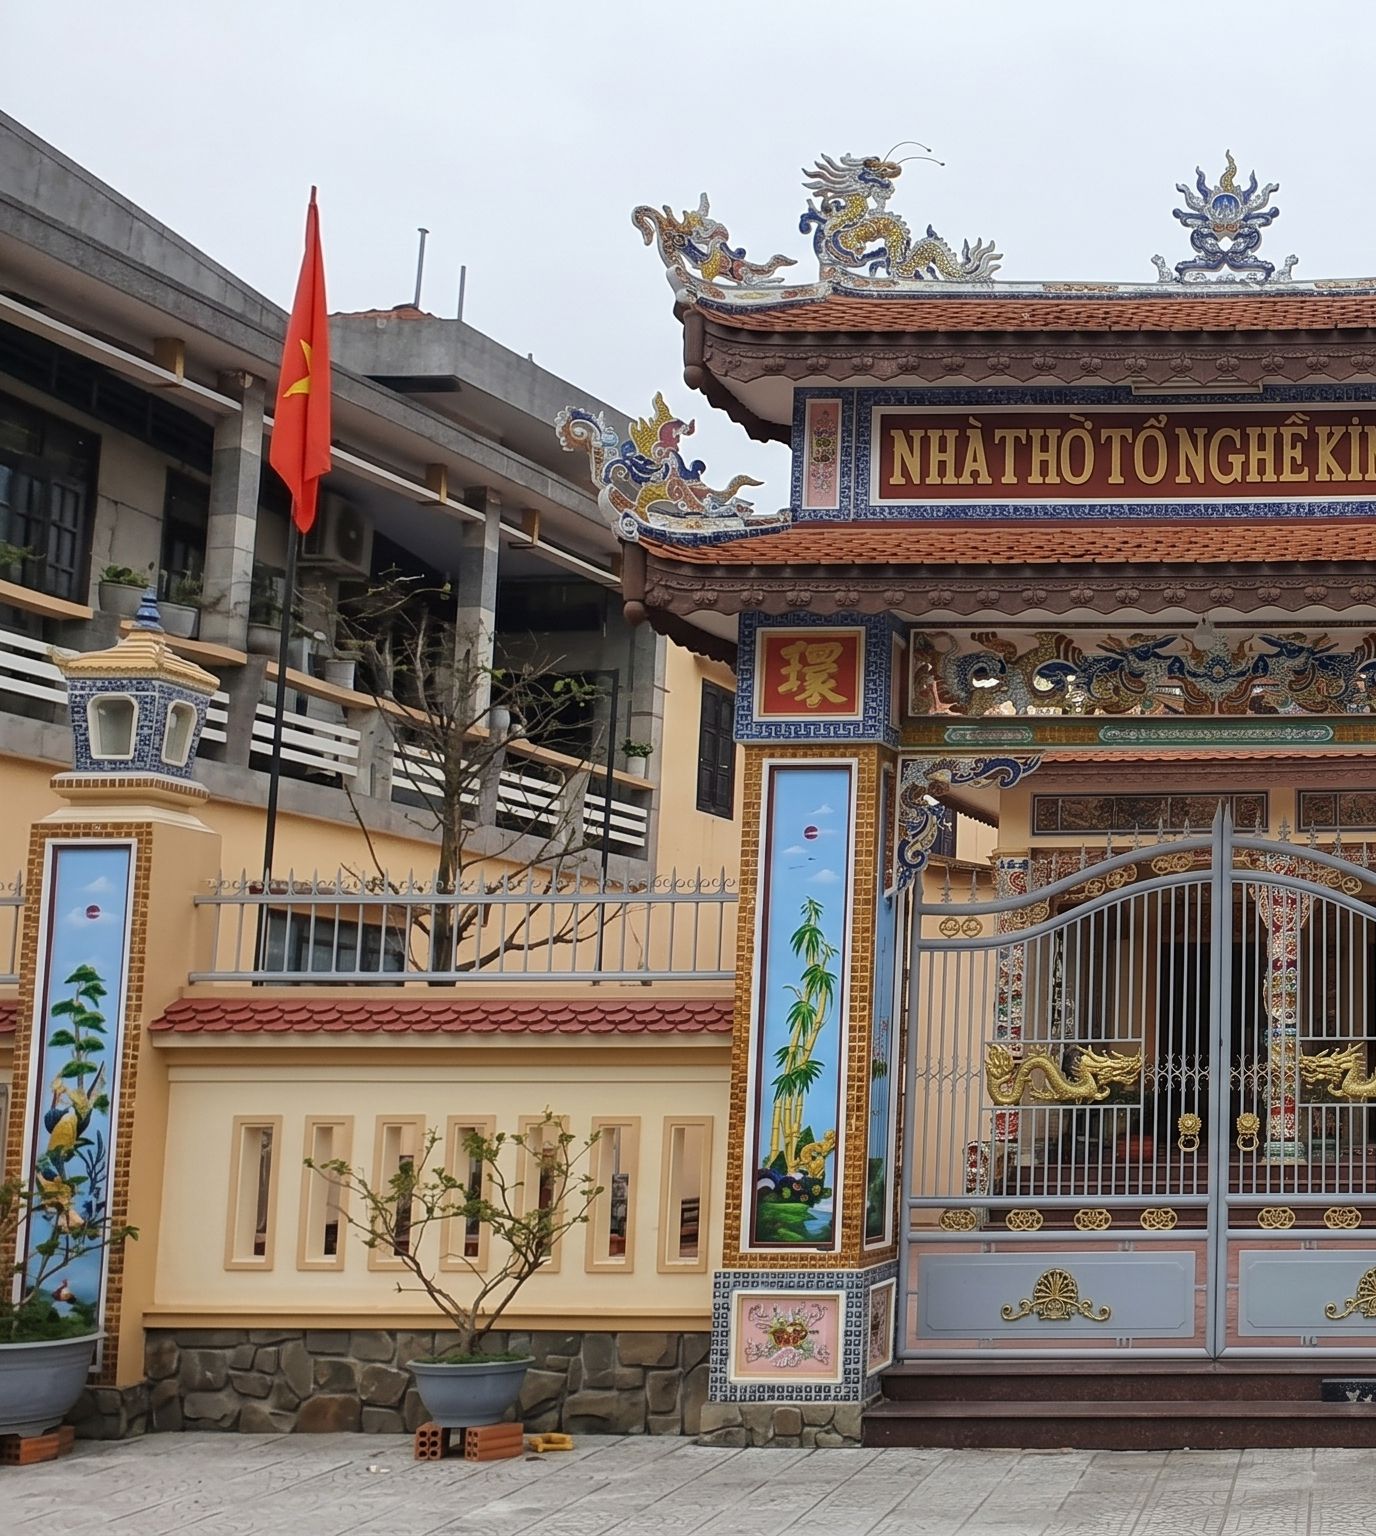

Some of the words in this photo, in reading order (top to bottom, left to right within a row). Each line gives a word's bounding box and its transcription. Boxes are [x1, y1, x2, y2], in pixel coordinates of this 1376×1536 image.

[889, 416, 992, 485] NHÀ
[994, 413, 1094, 485] THỜ
[1101, 414, 1168, 485] TỔ
[1175, 412, 1310, 484] NGHỀ
